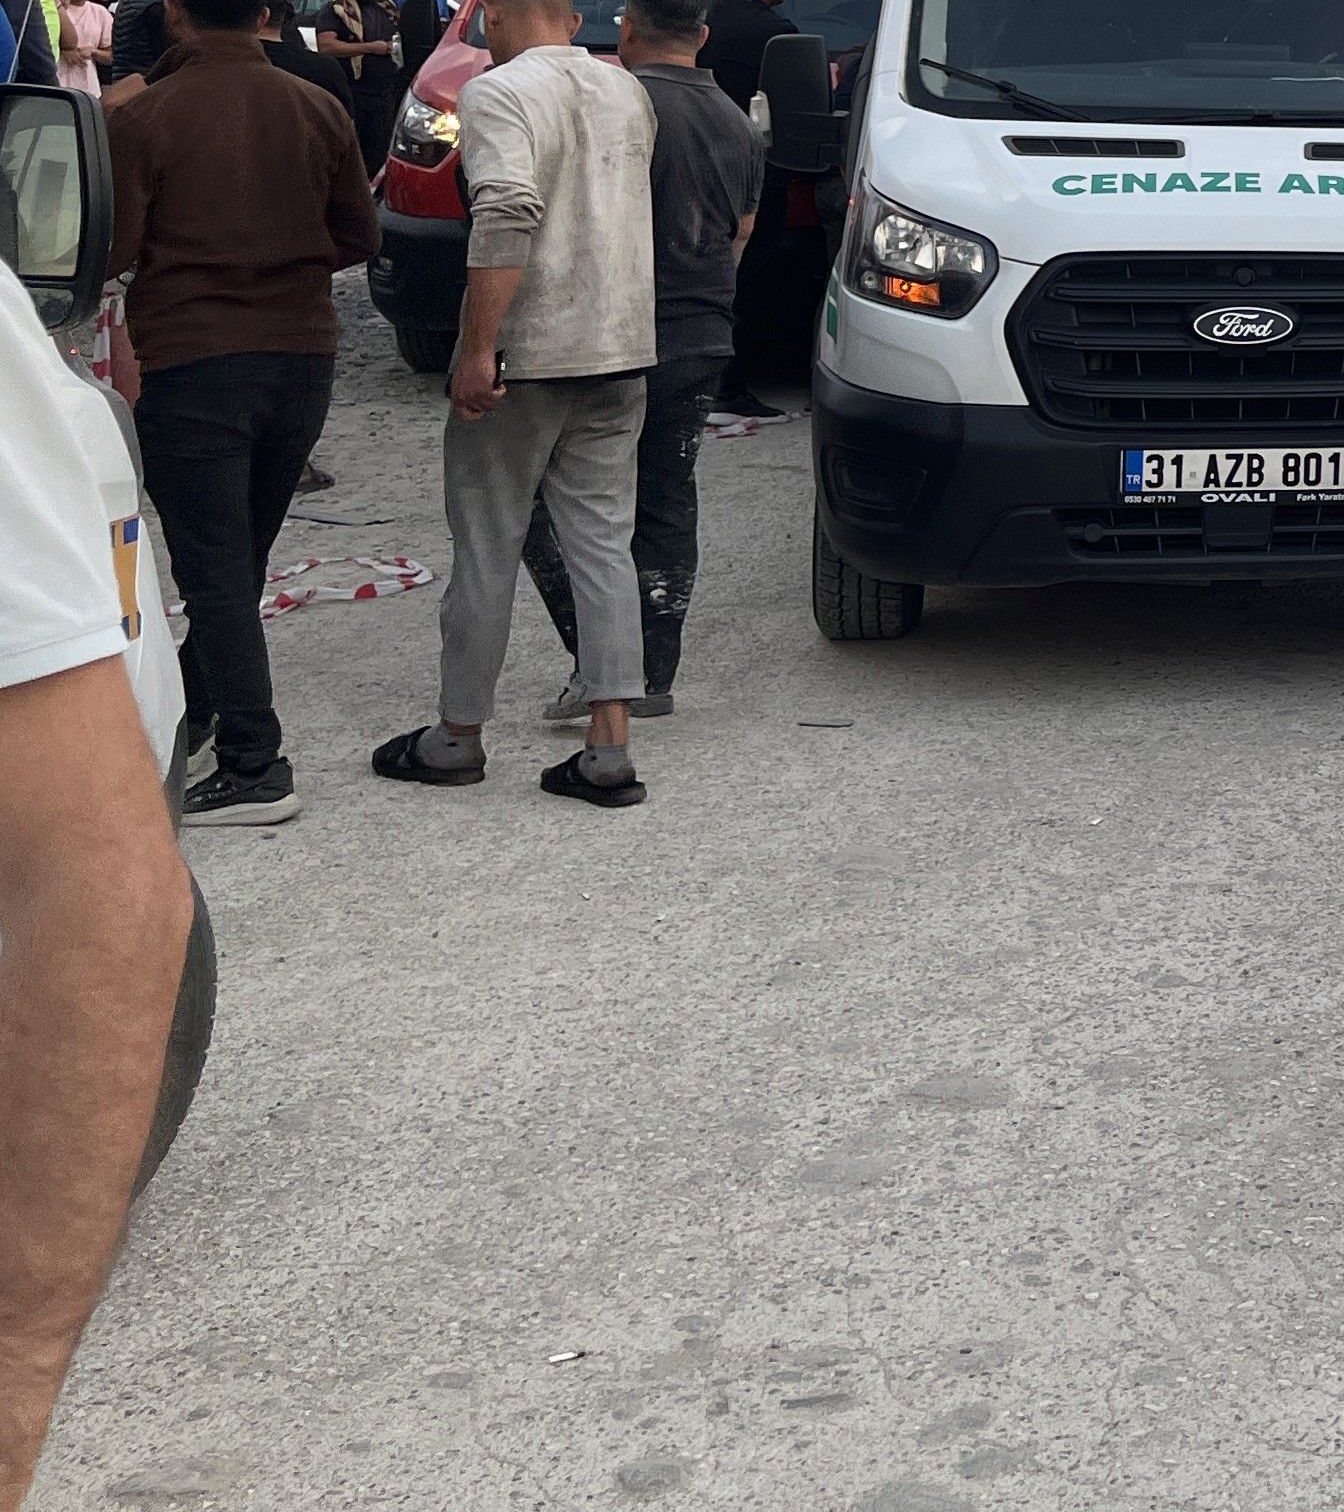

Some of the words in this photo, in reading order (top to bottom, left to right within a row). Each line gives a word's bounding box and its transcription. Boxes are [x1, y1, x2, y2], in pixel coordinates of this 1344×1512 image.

[1051, 172, 1262, 196] CENAZE
[1212, 312, 1275, 337] Ford
[1126, 474, 1142, 485] TR
[1144, 454, 1184, 489] 31
[1202, 453, 1265, 489] AZB
[1281, 452, 1341, 488] 801
[1200, 493, 1276, 503] OVALI
